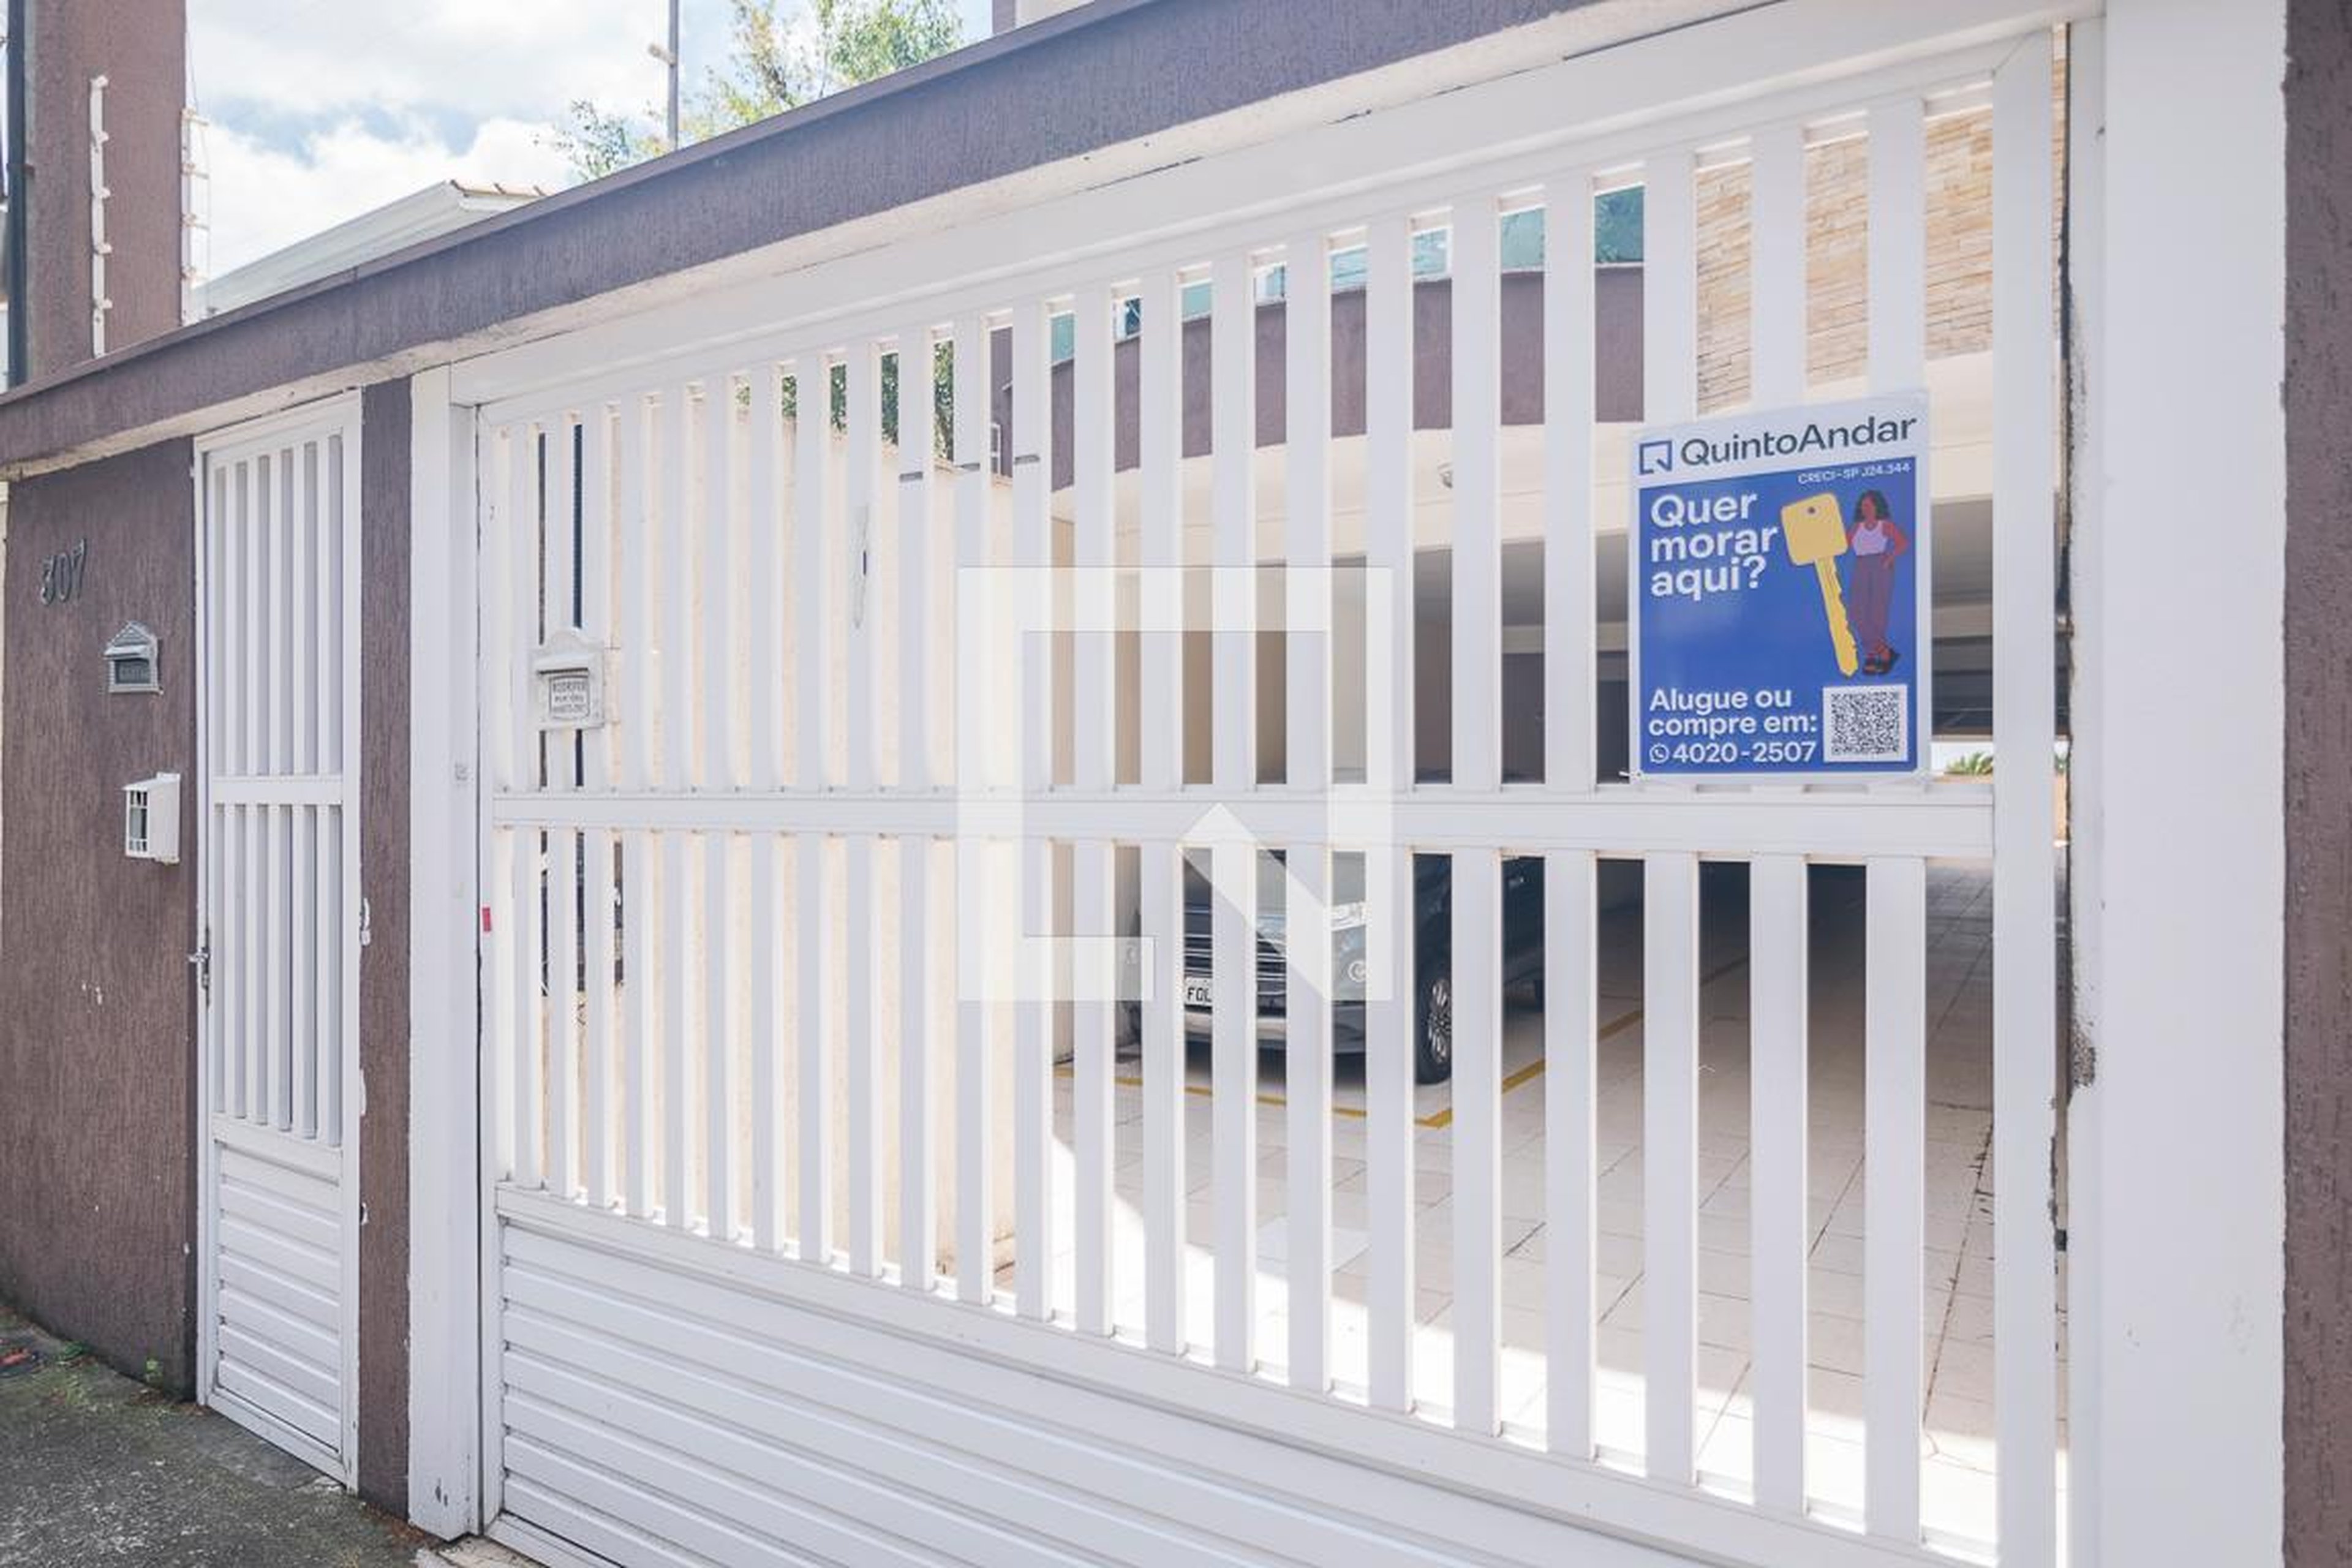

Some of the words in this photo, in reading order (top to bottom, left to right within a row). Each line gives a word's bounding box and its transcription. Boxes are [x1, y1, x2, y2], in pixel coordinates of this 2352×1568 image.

[1681, 417, 1917, 467] QuintoAndar
[1651, 494, 1758, 528] Quer
[1651, 527, 1779, 562] morar
[1651, 554, 1766, 601] aqui?
[1649, 688, 1749, 715] Alugue
[1755, 690, 1792, 707] ou
[1648, 716, 1757, 740] compre
[1763, 714, 1817, 733] em:
